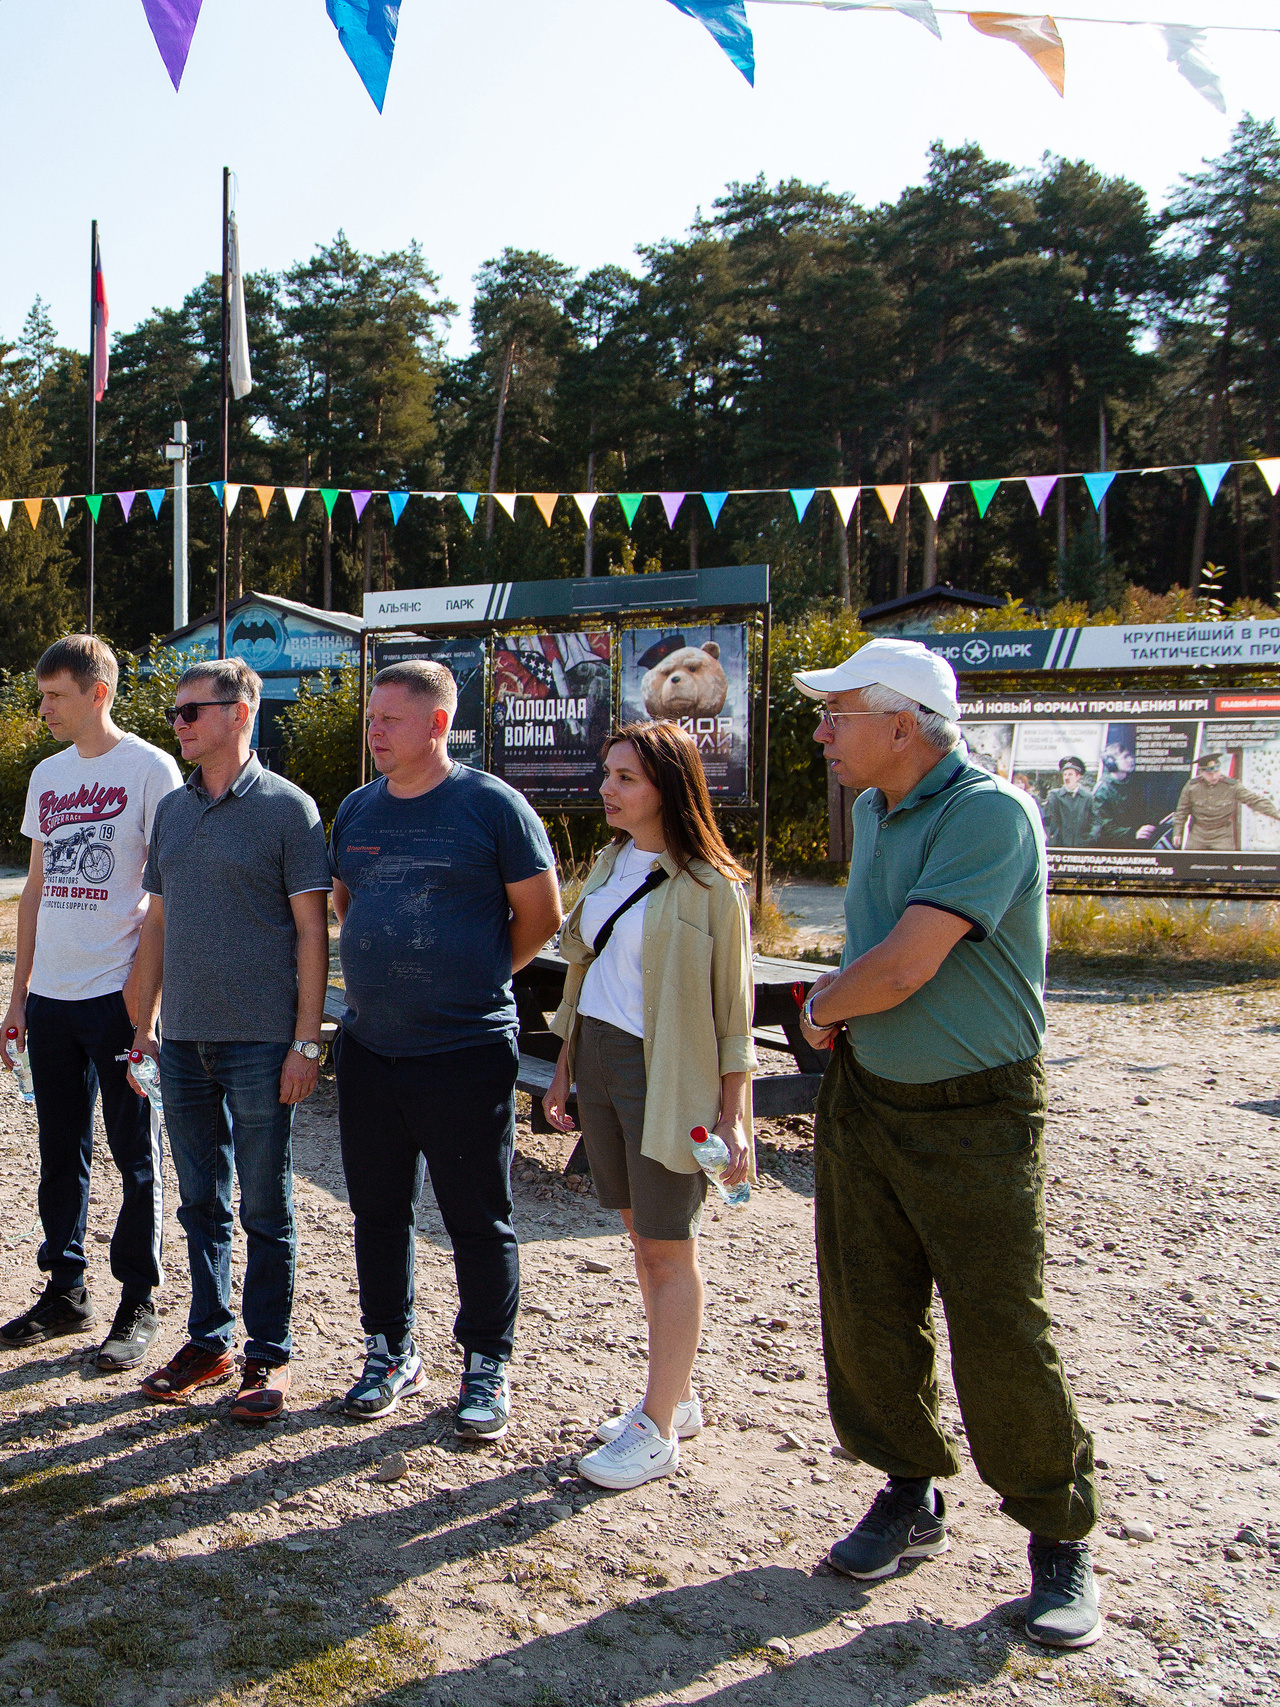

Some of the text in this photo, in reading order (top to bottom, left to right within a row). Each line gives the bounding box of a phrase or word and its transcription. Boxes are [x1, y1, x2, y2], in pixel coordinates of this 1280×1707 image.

[379, 599, 475, 614] АЛЬЯНС ПАРК
[1123, 626, 1234, 643] КРУПНЕЙШИЙ
[1241, 628, 1252, 639] В
[291, 636, 353, 650] ВОЕННАЯ
[992, 644, 1032, 658] ПАРК
[1131, 645, 1243, 660] ТАКТИЧЕСКИХ
[505, 696, 587, 722] ХОЛОДНАЯ
[960, 698, 1209, 714] ТАЙ НОВЫЙ ФОРМАТ ПРОВЕДЕНИЯ ИГР!
[504, 722, 555, 747] ВОЙНА
[39, 782, 128, 822] Brooklyn
[102, 825, 114, 840] 19
[1057, 864, 1091, 873] АГЕНТЫ
[1143, 866, 1174, 875] СЛУЖБ
[51, 886, 69, 898] FOR
[71, 887, 109, 901] SPEED
